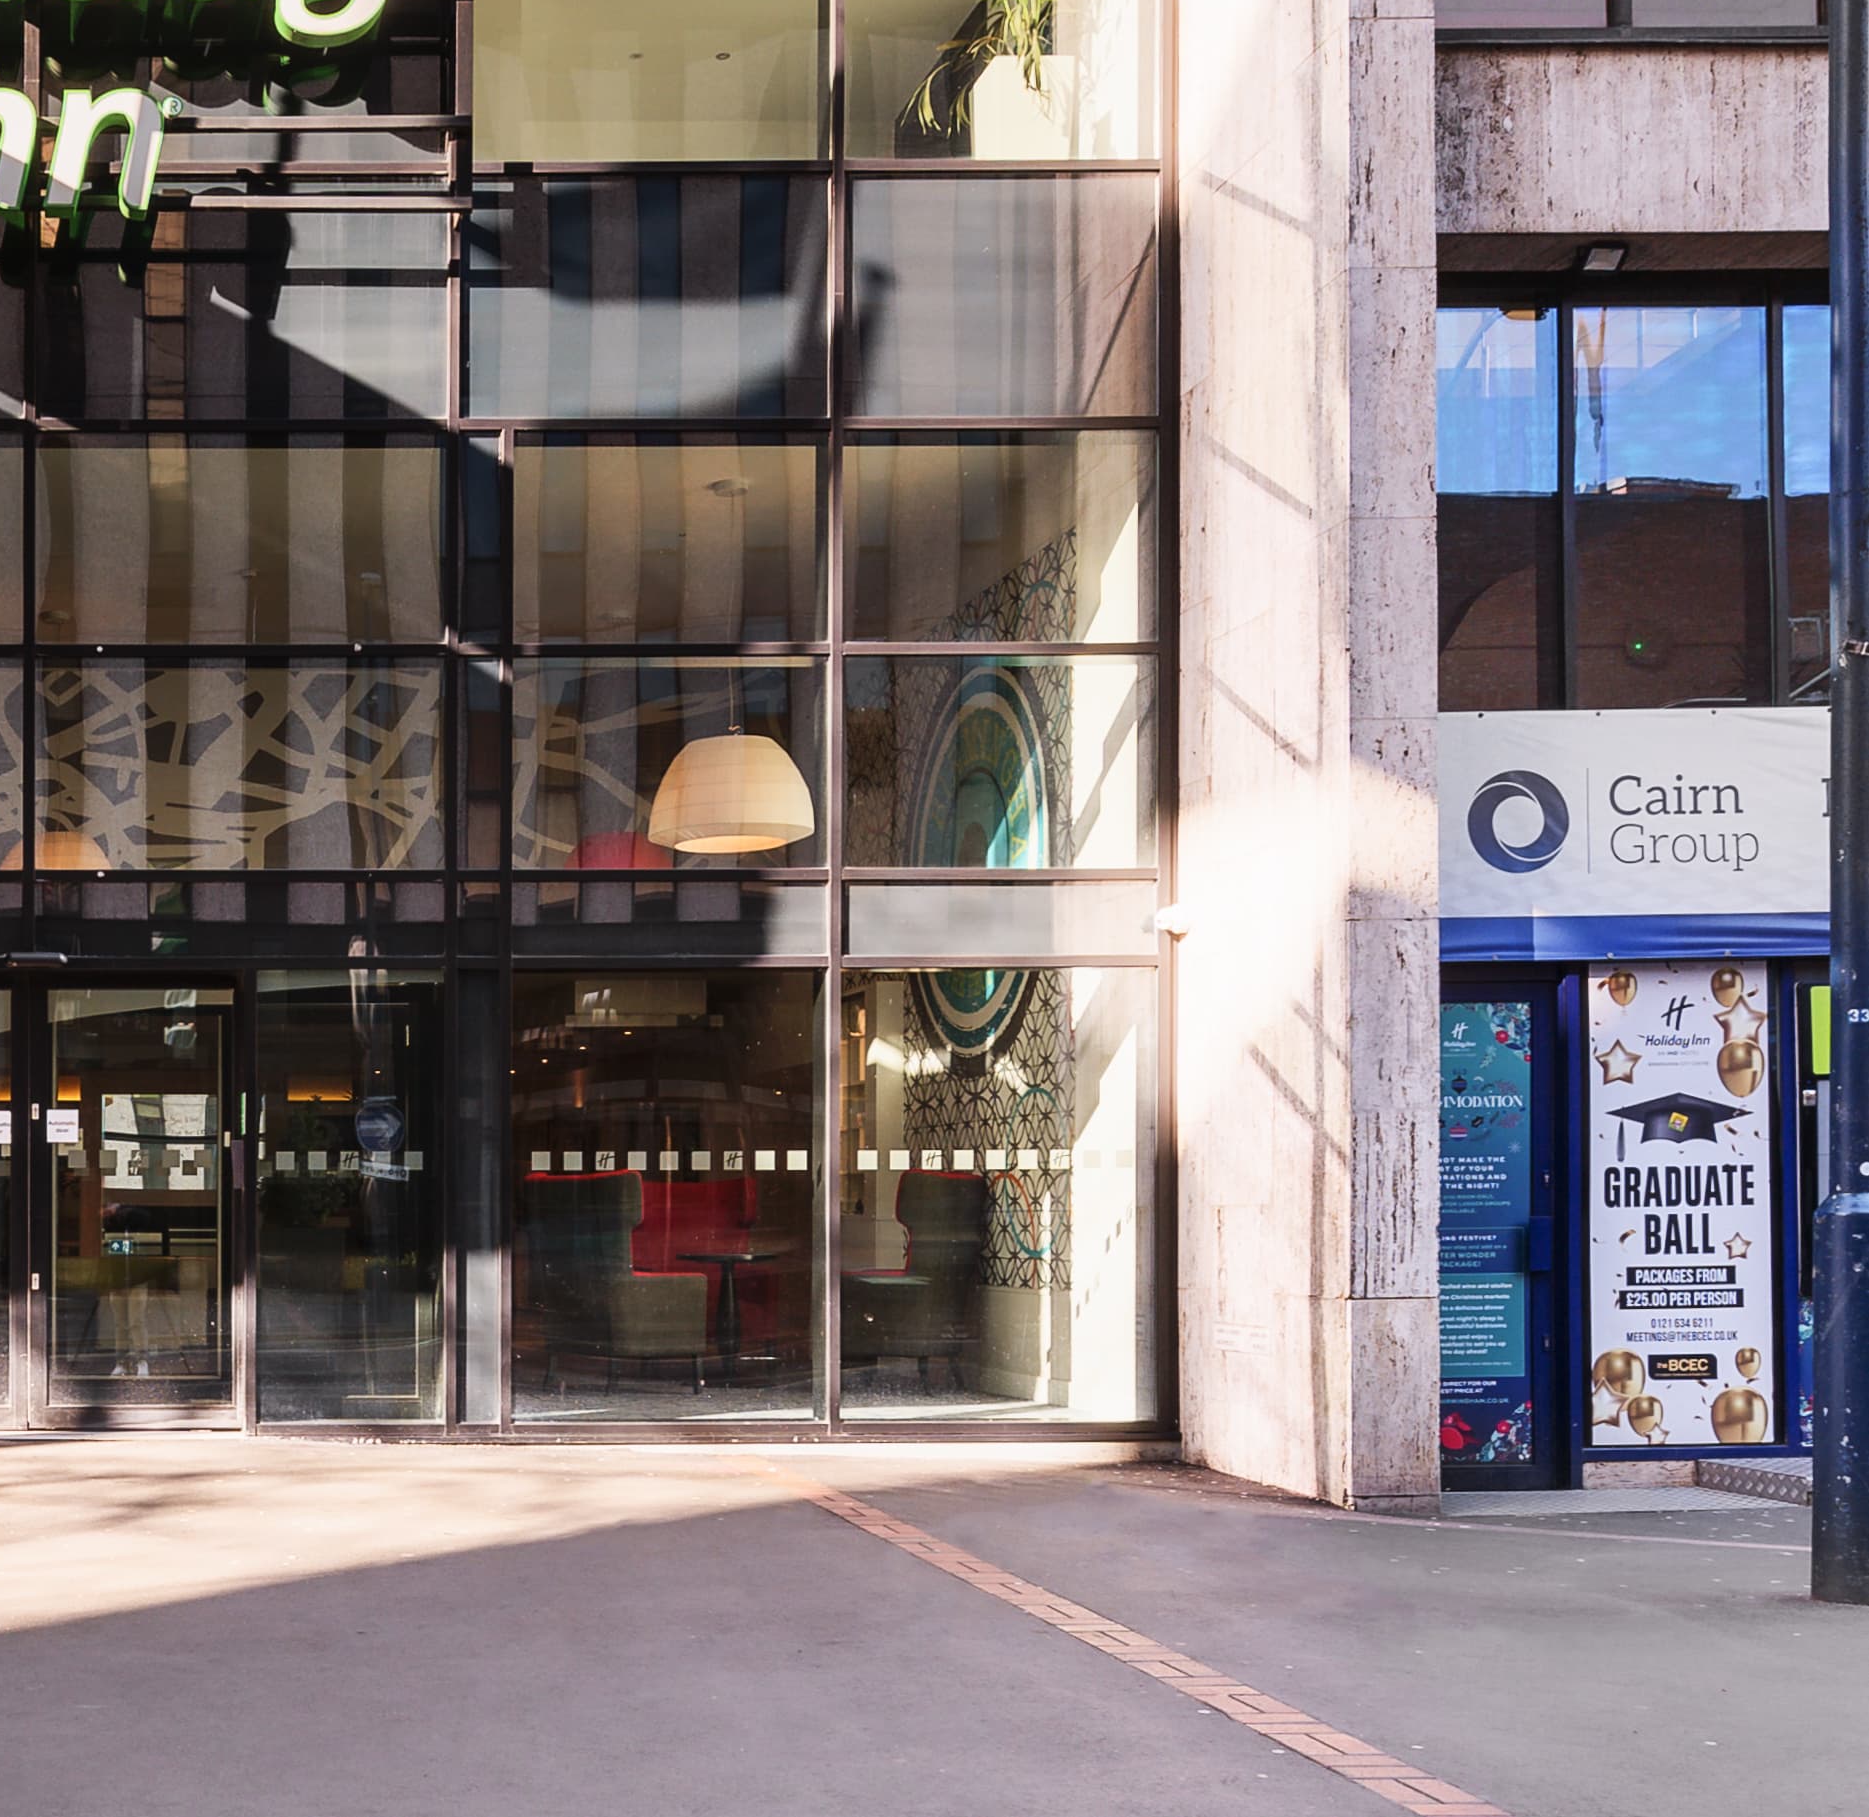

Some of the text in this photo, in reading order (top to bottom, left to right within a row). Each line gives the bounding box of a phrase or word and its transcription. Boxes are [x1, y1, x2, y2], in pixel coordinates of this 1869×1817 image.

[1609, 774, 1744, 816] Cairn
[1609, 823, 1760, 872] Group
[1644, 1034, 1711, 1049] Holiday Inn
[1458, 1156, 1484, 1164] MAKE
[1468, 1164, 1495, 1172] YOUR
[1486, 1173, 1508, 1181] AND
[1445, 1182, 1464, 1190] THE
[1604, 1164, 1755, 1209] GRADUATE
[1644, 1213, 1716, 1255] BALL
[1635, 1268, 1728, 1284] PACKAGES FROM
[1626, 1290, 1738, 1307] £25.00 PER PERSON
[1650, 1317, 1714, 1329] 0121 634 6211
[1626, 1330, 1738, 1343] MEETINGS@THEBCEC.CO.UK
[1668, 1359, 1709, 1372] BCEC
